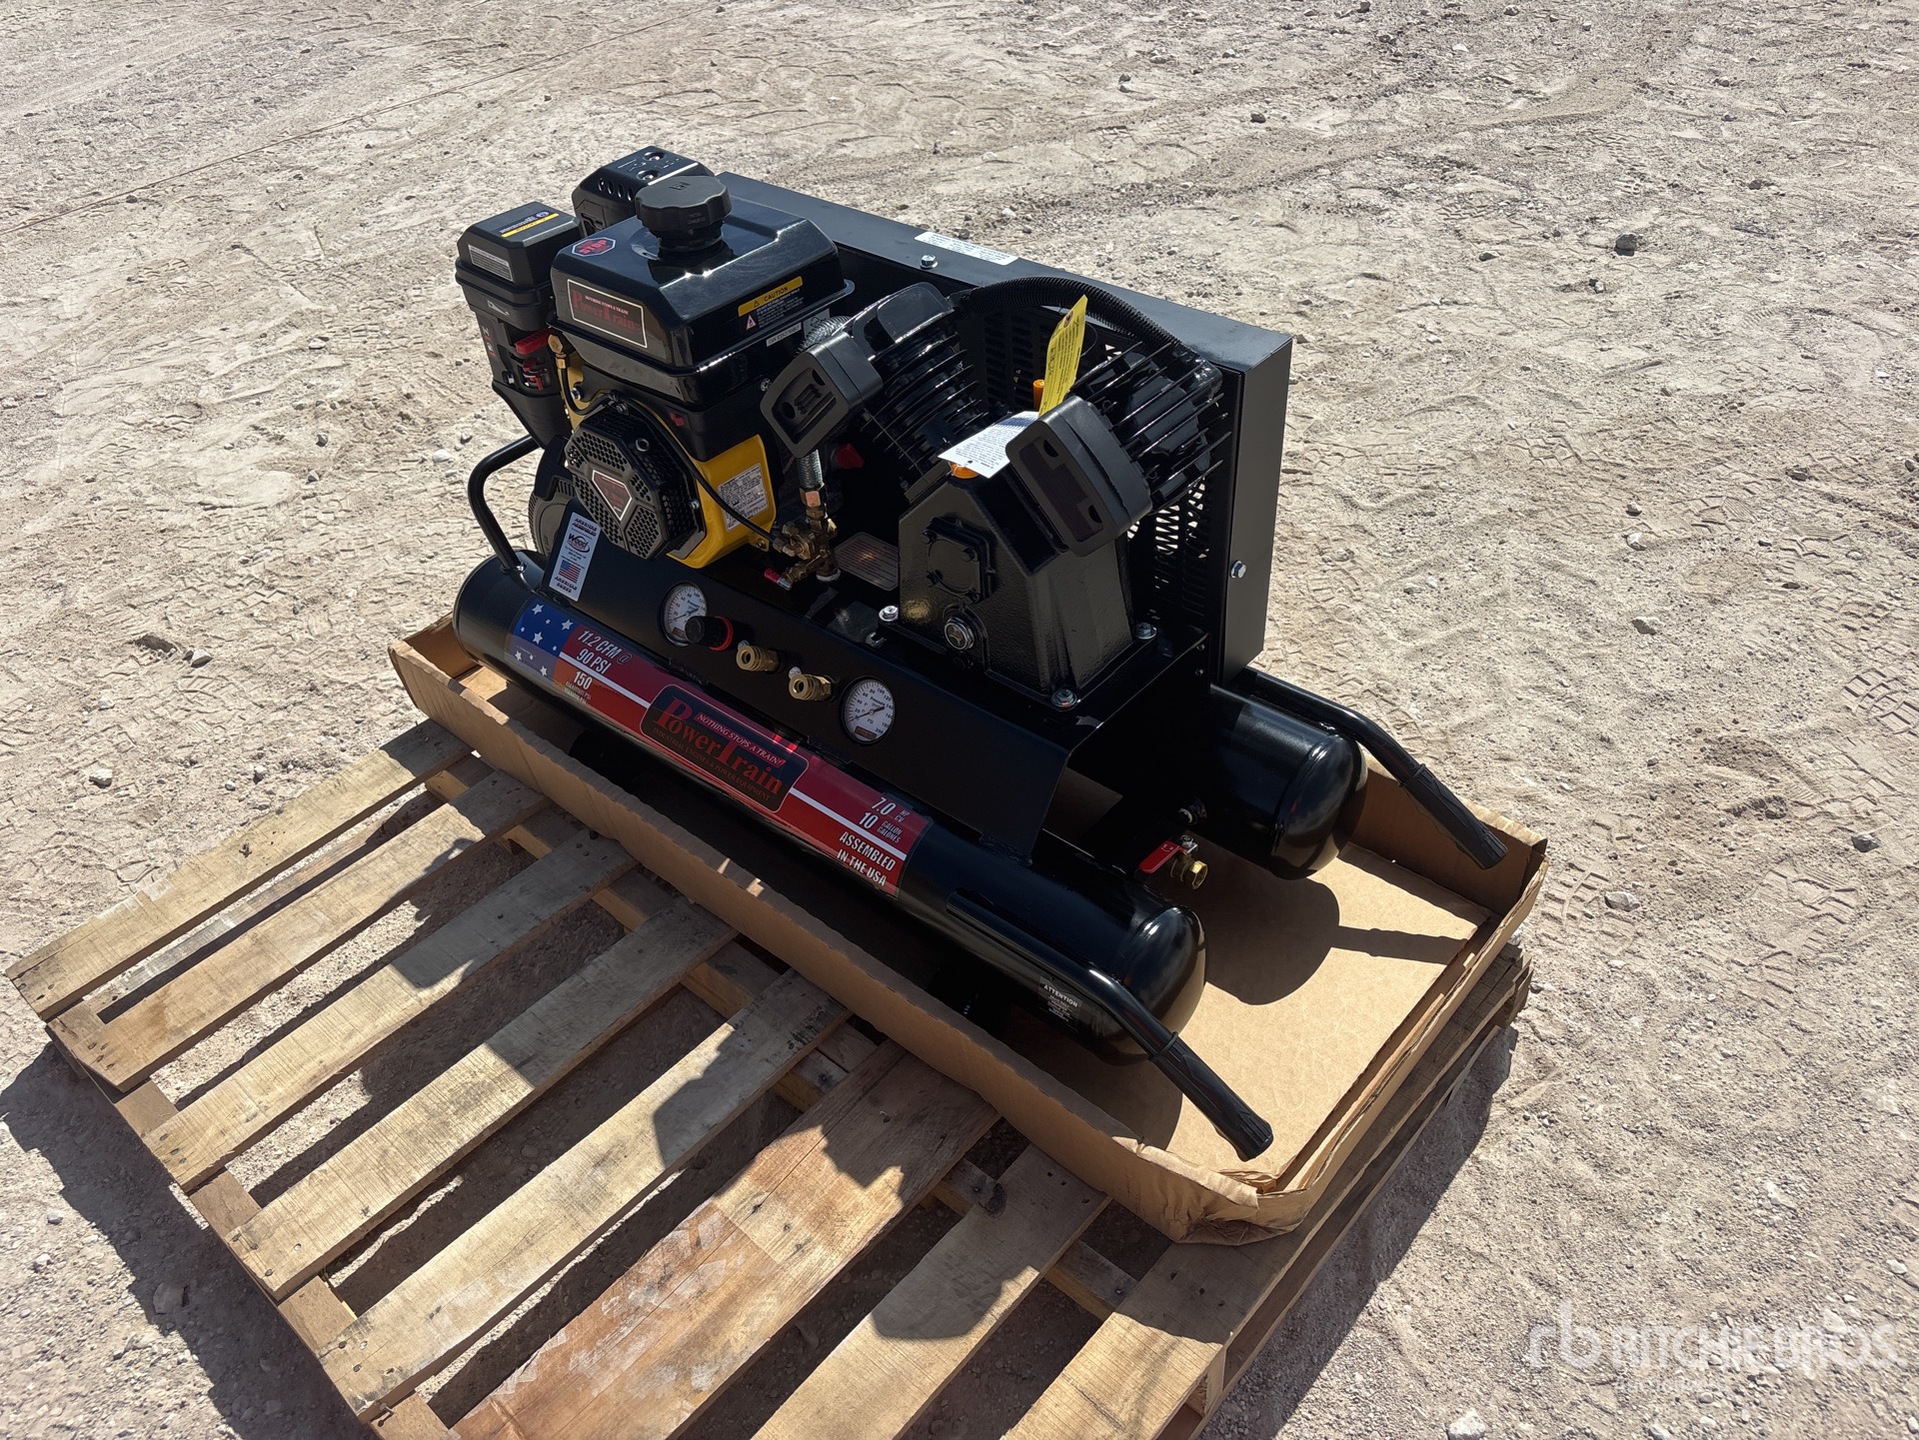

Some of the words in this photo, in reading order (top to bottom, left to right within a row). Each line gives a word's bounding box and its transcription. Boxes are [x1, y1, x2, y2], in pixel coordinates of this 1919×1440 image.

[763, 286, 789, 302] CAUTION
[577, 648, 591, 664] 90
[590, 655, 613, 675] PSI
[578, 630, 601, 648] 11.2
[595, 638, 623, 660] CFM
[617, 653, 633, 665] @
[573, 671, 593, 690] 150
[653, 697, 783, 795] PowerTrain
[697, 713, 729, 737] NOTHING
[727, 732, 752, 749] STOPS
[714, 764, 737, 782] POWER
[735, 776, 771, 801] EQUIPMENT
[859, 812, 879, 829] 10
[871, 797, 897, 816] 7.0
[839, 831, 896, 871] ASSEMBLED
[837, 849, 849, 863] IN
[848, 855, 868, 874] THE
[866, 867, 887, 886] USA
[1043, 984, 1078, 1008] ATTENTION
